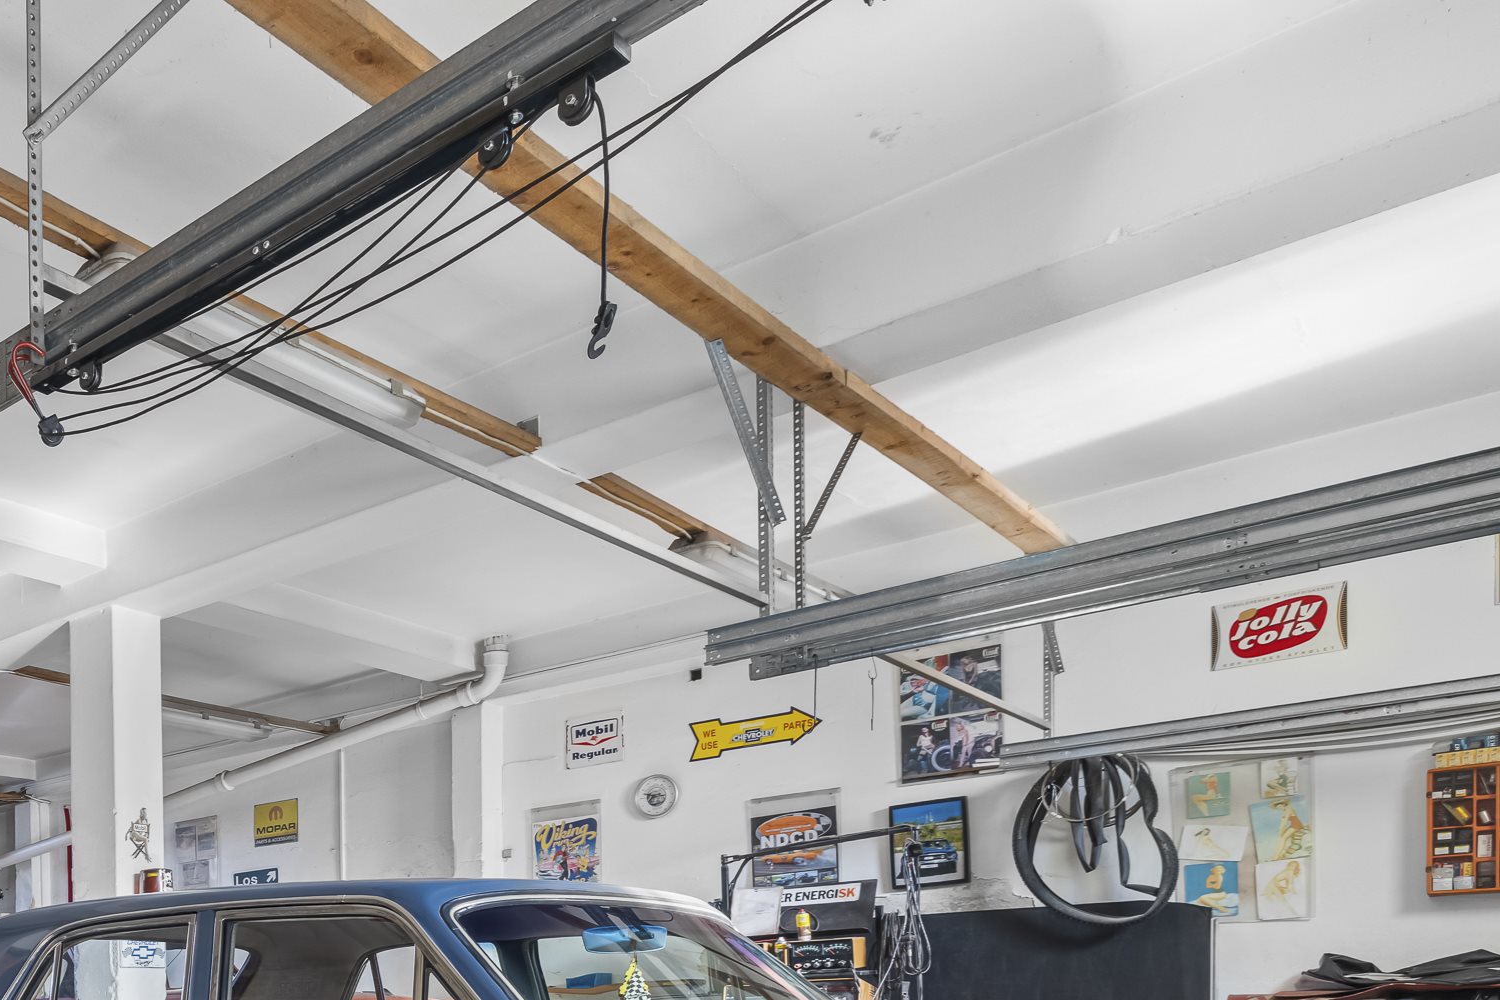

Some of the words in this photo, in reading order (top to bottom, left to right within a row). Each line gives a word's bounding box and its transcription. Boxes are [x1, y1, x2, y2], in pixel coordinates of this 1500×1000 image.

[575, 723, 614, 738] Mobil
[783, 719, 814, 731] PARTS
[703, 729, 717, 738] WE
[731, 728, 775, 742] CHEVROLET
[701, 740, 719, 750] USE
[572, 747, 619, 760] Regular
[256, 822, 296, 835] MOPAR
[536, 820, 597, 850] Viking
[795, 888, 856, 902] ENERGISK
